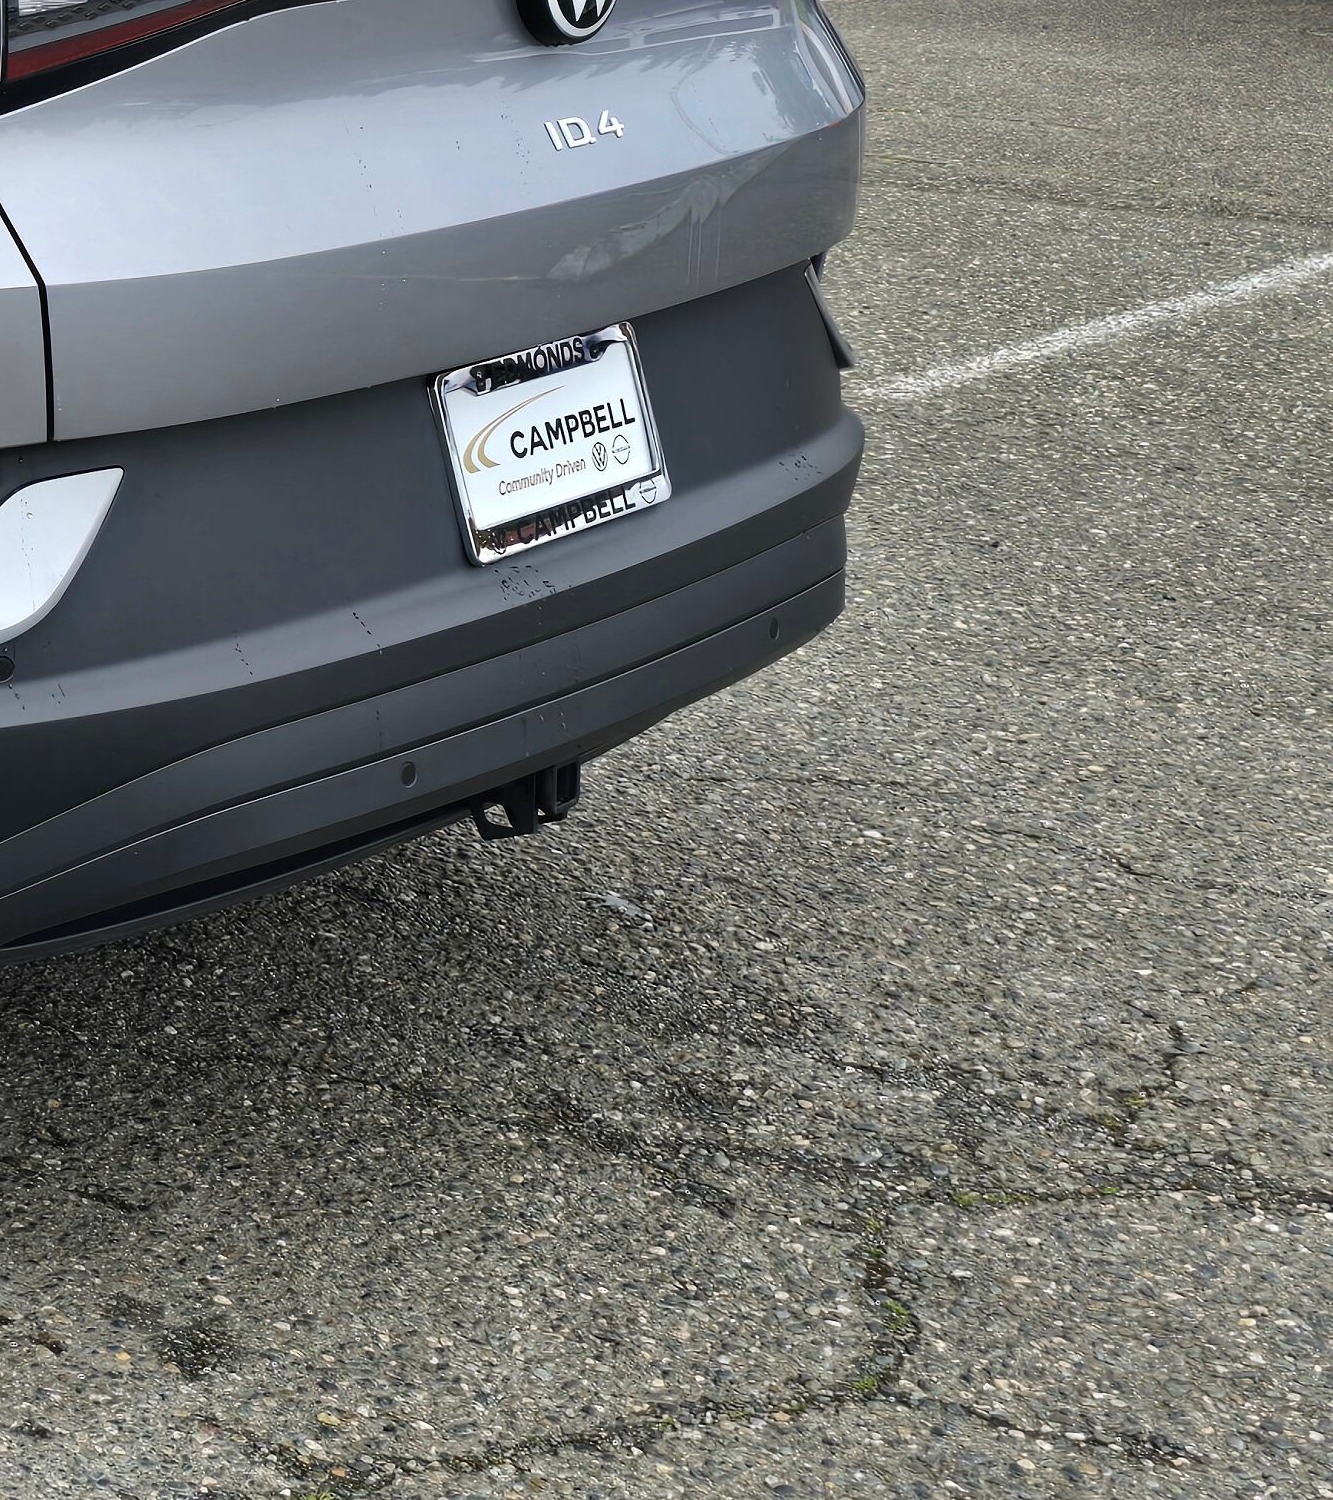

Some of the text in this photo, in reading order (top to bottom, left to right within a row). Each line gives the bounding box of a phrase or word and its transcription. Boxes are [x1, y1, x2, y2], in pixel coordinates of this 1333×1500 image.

[509, 398, 636, 459] CAMPBELL
[498, 458, 587, 496] Community Driven
[517, 485, 637, 545] CAMPBELL
